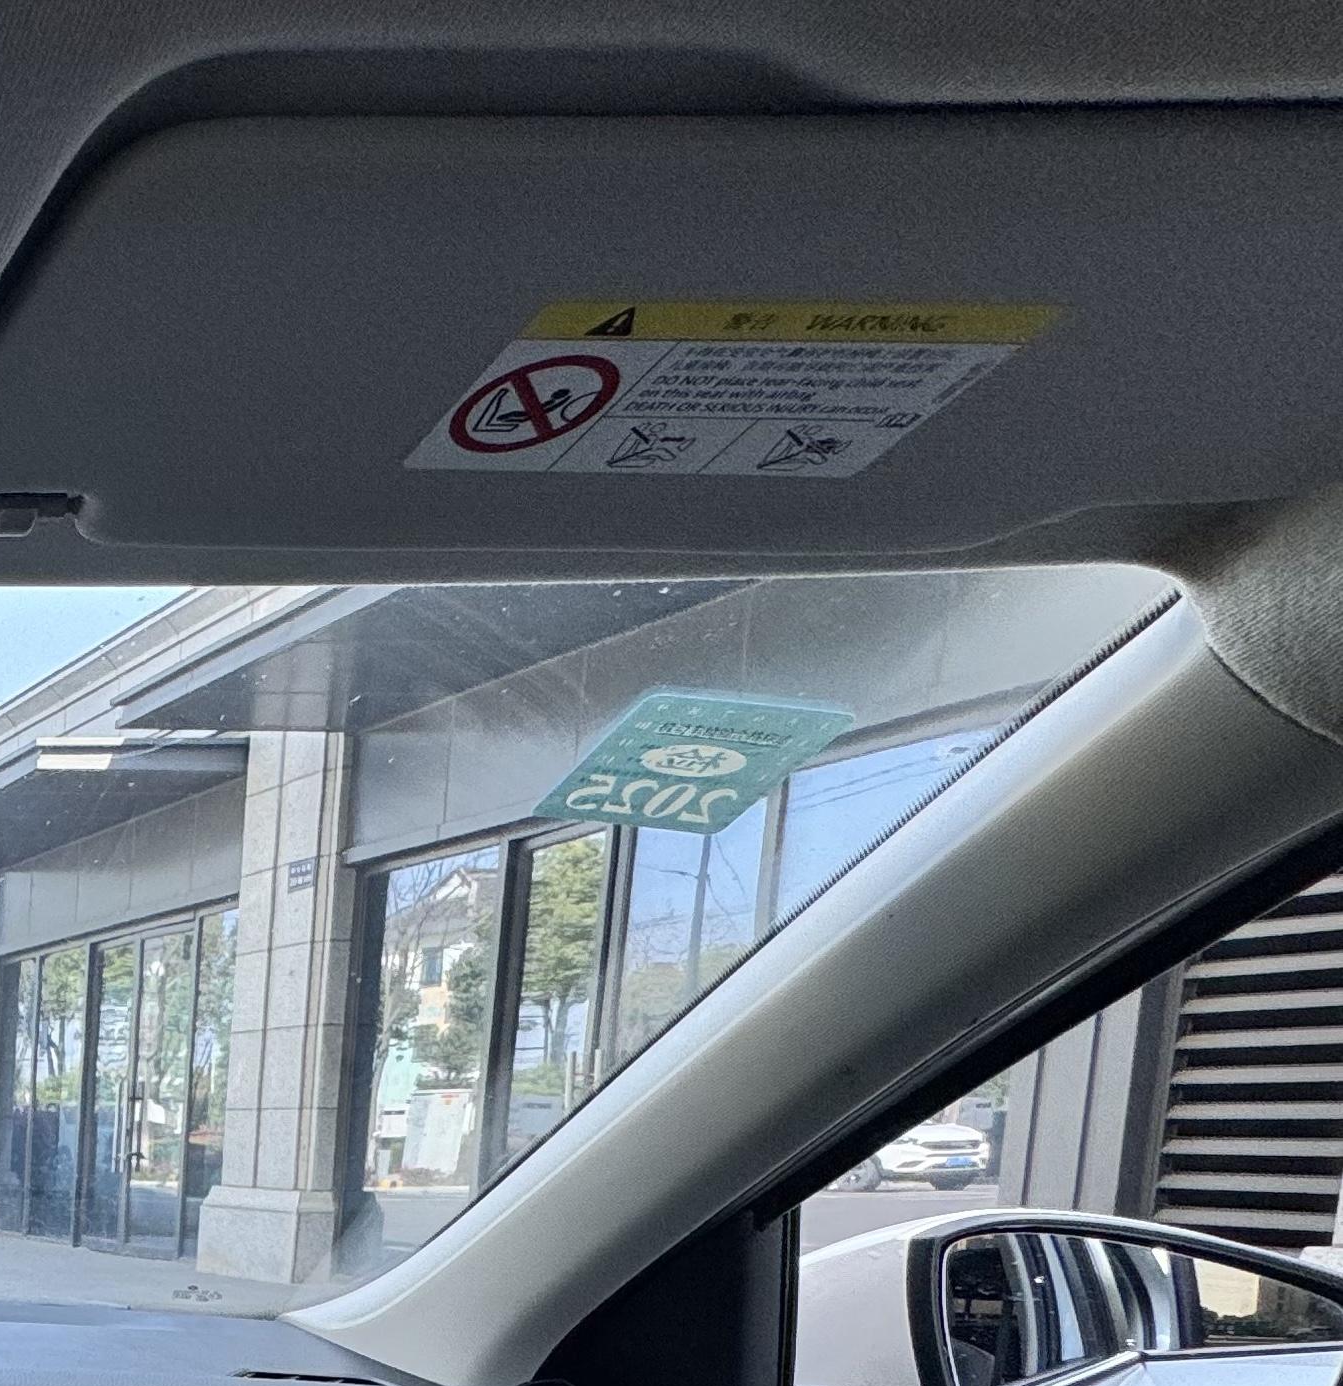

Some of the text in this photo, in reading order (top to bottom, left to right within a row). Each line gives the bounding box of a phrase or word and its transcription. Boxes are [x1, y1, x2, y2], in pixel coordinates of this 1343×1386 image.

[805, 314, 950, 332] WARNING
[652, 375, 679, 386] DO
[679, 375, 718, 386] NOT
[713, 376, 758, 388] place
[638, 389, 660, 397] on
[661, 389, 690, 398] this
[693, 390, 727, 398] seat
[729, 389, 765, 398] with
[625, 401, 676, 411] DEATH
[676, 402, 702, 411] OR
[702, 403, 767, 412] SERIOUS
